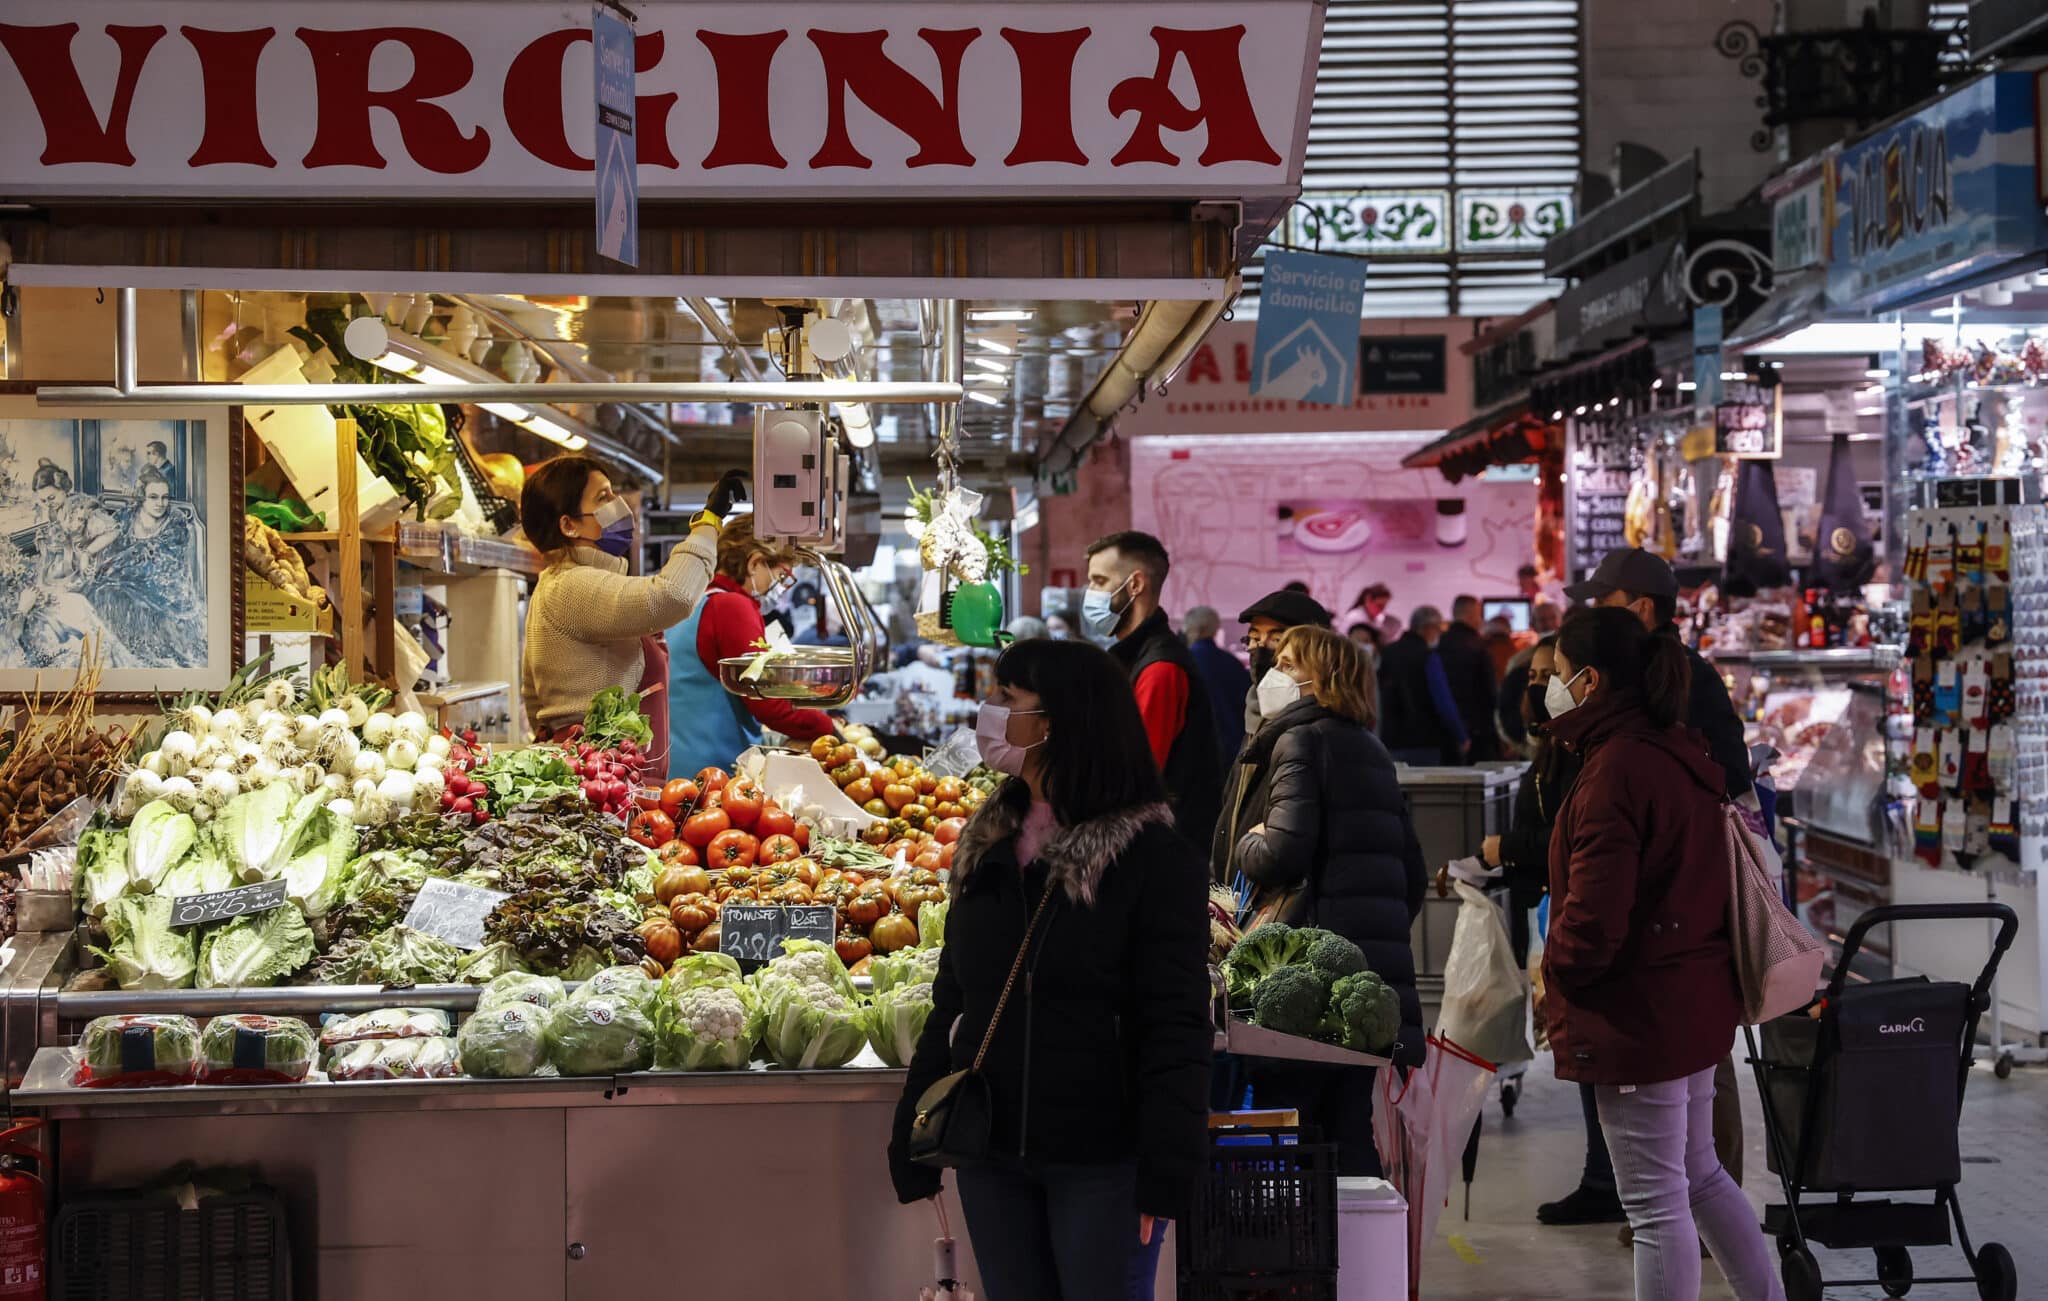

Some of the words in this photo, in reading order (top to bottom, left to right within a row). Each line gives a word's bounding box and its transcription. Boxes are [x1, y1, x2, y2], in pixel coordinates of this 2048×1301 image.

[0, 22, 1282, 174] VIRGINIA
[1851, 127, 1952, 257] VALENCIA
[1270, 264, 1345, 290] Servicio
[1350, 278, 1361, 293] a
[175, 886, 263, 905] LECHUGAS
[727, 908, 779, 923] TOMATE
